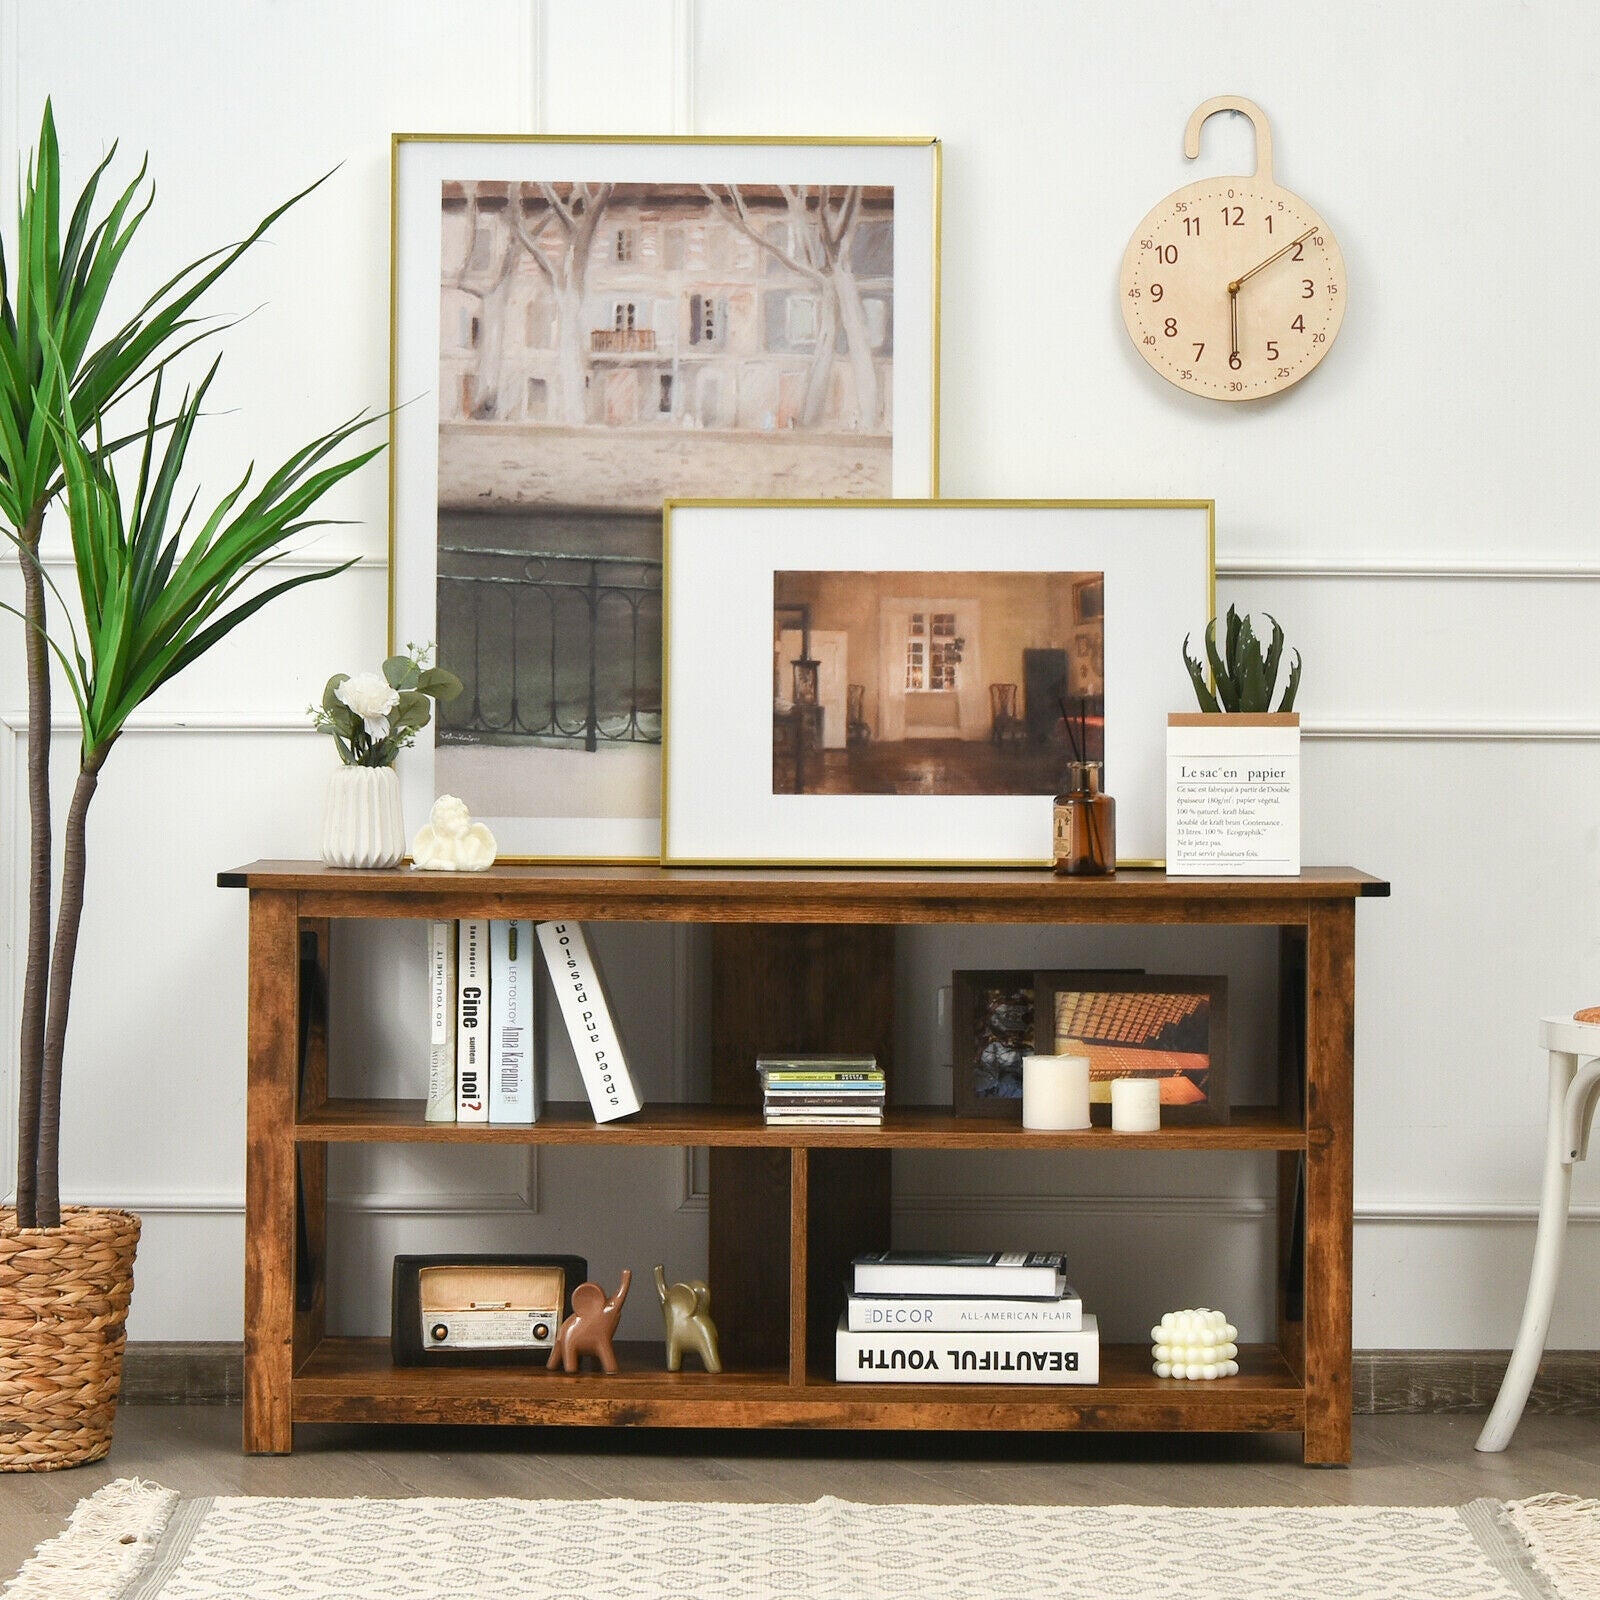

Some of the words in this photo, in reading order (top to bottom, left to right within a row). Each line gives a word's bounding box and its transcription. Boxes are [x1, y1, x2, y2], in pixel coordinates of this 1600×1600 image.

[1228, 190, 1234, 198] 0
[1176, 202, 1188, 212] 55
[1278, 202, 1284, 211] 5
[1221, 206, 1245, 226] 12
[1265, 215, 1272, 234] 1
[1183, 217, 1200, 236] 11
[1141, 240, 1152, 249] 50
[1313, 236, 1323, 246] 10
[1155, 244, 1178, 264] 10
[1292, 242, 1304, 262] 2
[1128, 288, 1140, 297] 45
[1150, 284, 1163, 302] 9
[1302, 280, 1314, 299] 3
[1327, 285, 1337, 294] 15
[1164, 318, 1178, 337] 8
[1291, 315, 1305, 333] 4
[1143, 336, 1155, 345] 40
[1313, 333, 1325, 342] 20
[1192, 343, 1205, 362] 7
[1267, 342, 1279, 360] 5
[1229, 351, 1242, 370] 6
[1180, 370, 1192, 380] 35
[1278, 368, 1290, 377] 25
[1230, 382, 1242, 392] 30
[1181, 766, 1197, 778] Le
[1223, 770, 1237, 778] en
[1248, 768, 1286, 781] papier
[1240, 787, 1257, 795] partir
[1217, 850, 1244, 858] plusieurs
[436, 951, 443, 960] IT
[555, 924, 588, 1003] passion
[508, 966, 517, 983] LEO
[462, 987, 482, 1028] Cine
[508, 985, 517, 1024] TOLSTOY
[436, 1012, 443, 1027] DO
[582, 1012, 600, 1043] and
[502, 1026, 524, 1048] Anna
[501, 1052, 523, 1093] Karenina
[595, 1051, 619, 1106] speed
[872, 1309, 934, 1323] DECOR
[960, 1312, 1038, 1320] ALL-AMERICAN
[1042, 1312, 1072, 1320] FLAIR
[858, 1349, 939, 1369] YOUTH
[947, 1350, 1079, 1371] BEAUTIFUL
